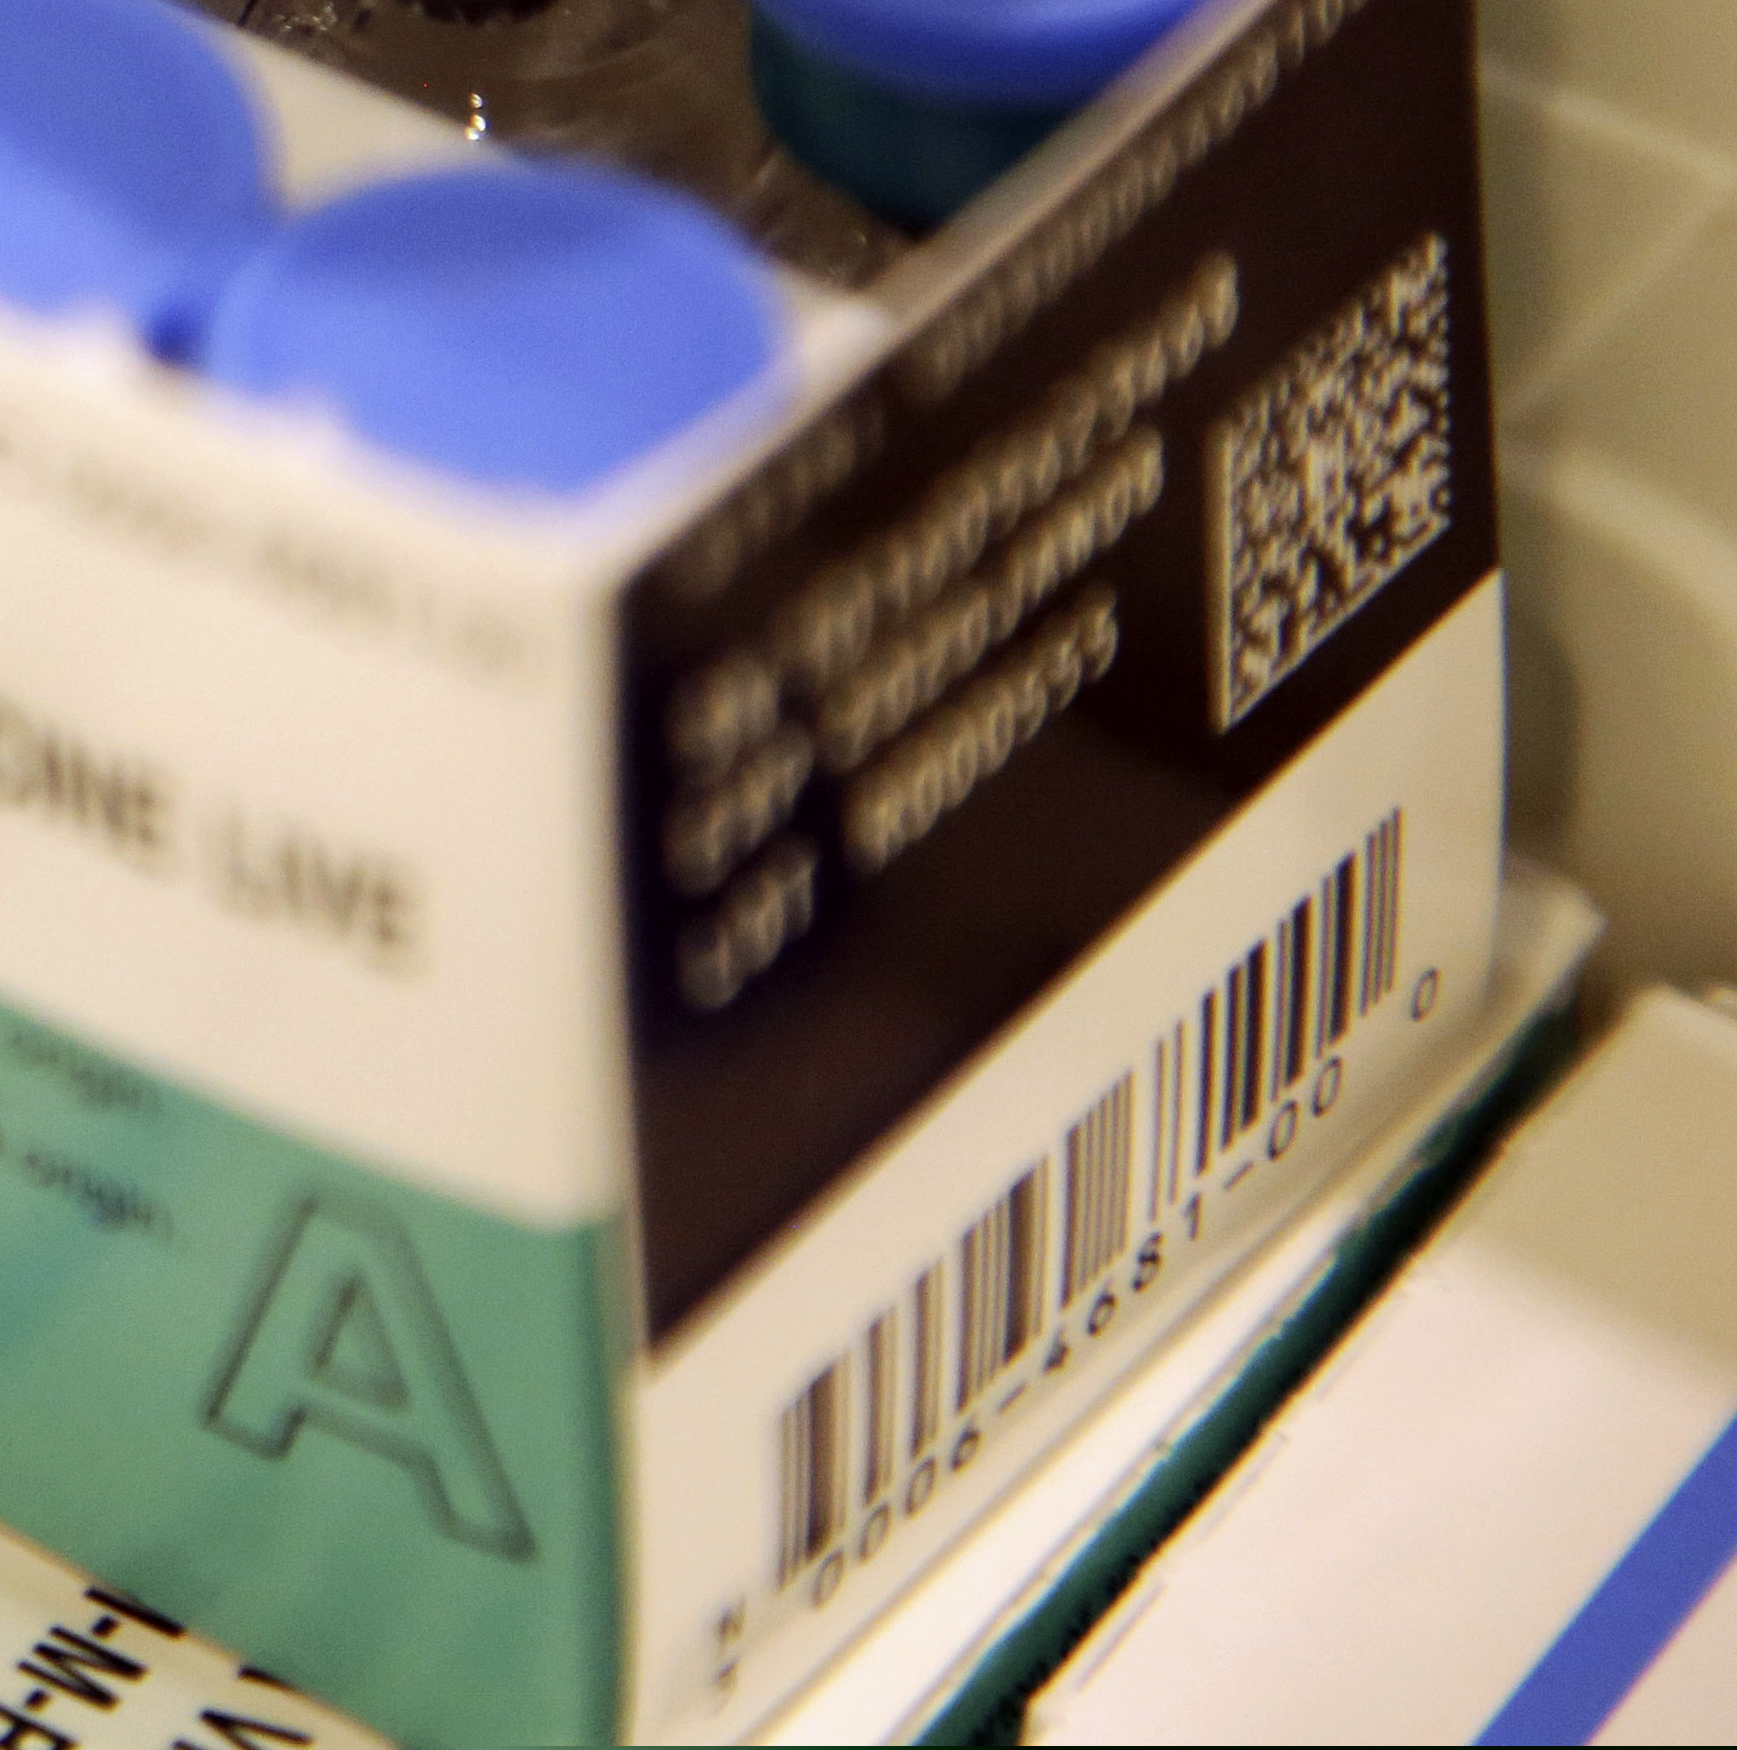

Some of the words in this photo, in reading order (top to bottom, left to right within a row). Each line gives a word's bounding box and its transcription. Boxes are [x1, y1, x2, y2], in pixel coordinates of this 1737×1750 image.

[213, 789, 429, 1000] LIVE
[1409, 965, 1441, 1023] 0
[202, 1184, 538, 1561] A
[811, 1057, 1345, 1609] 0006-4681-00
